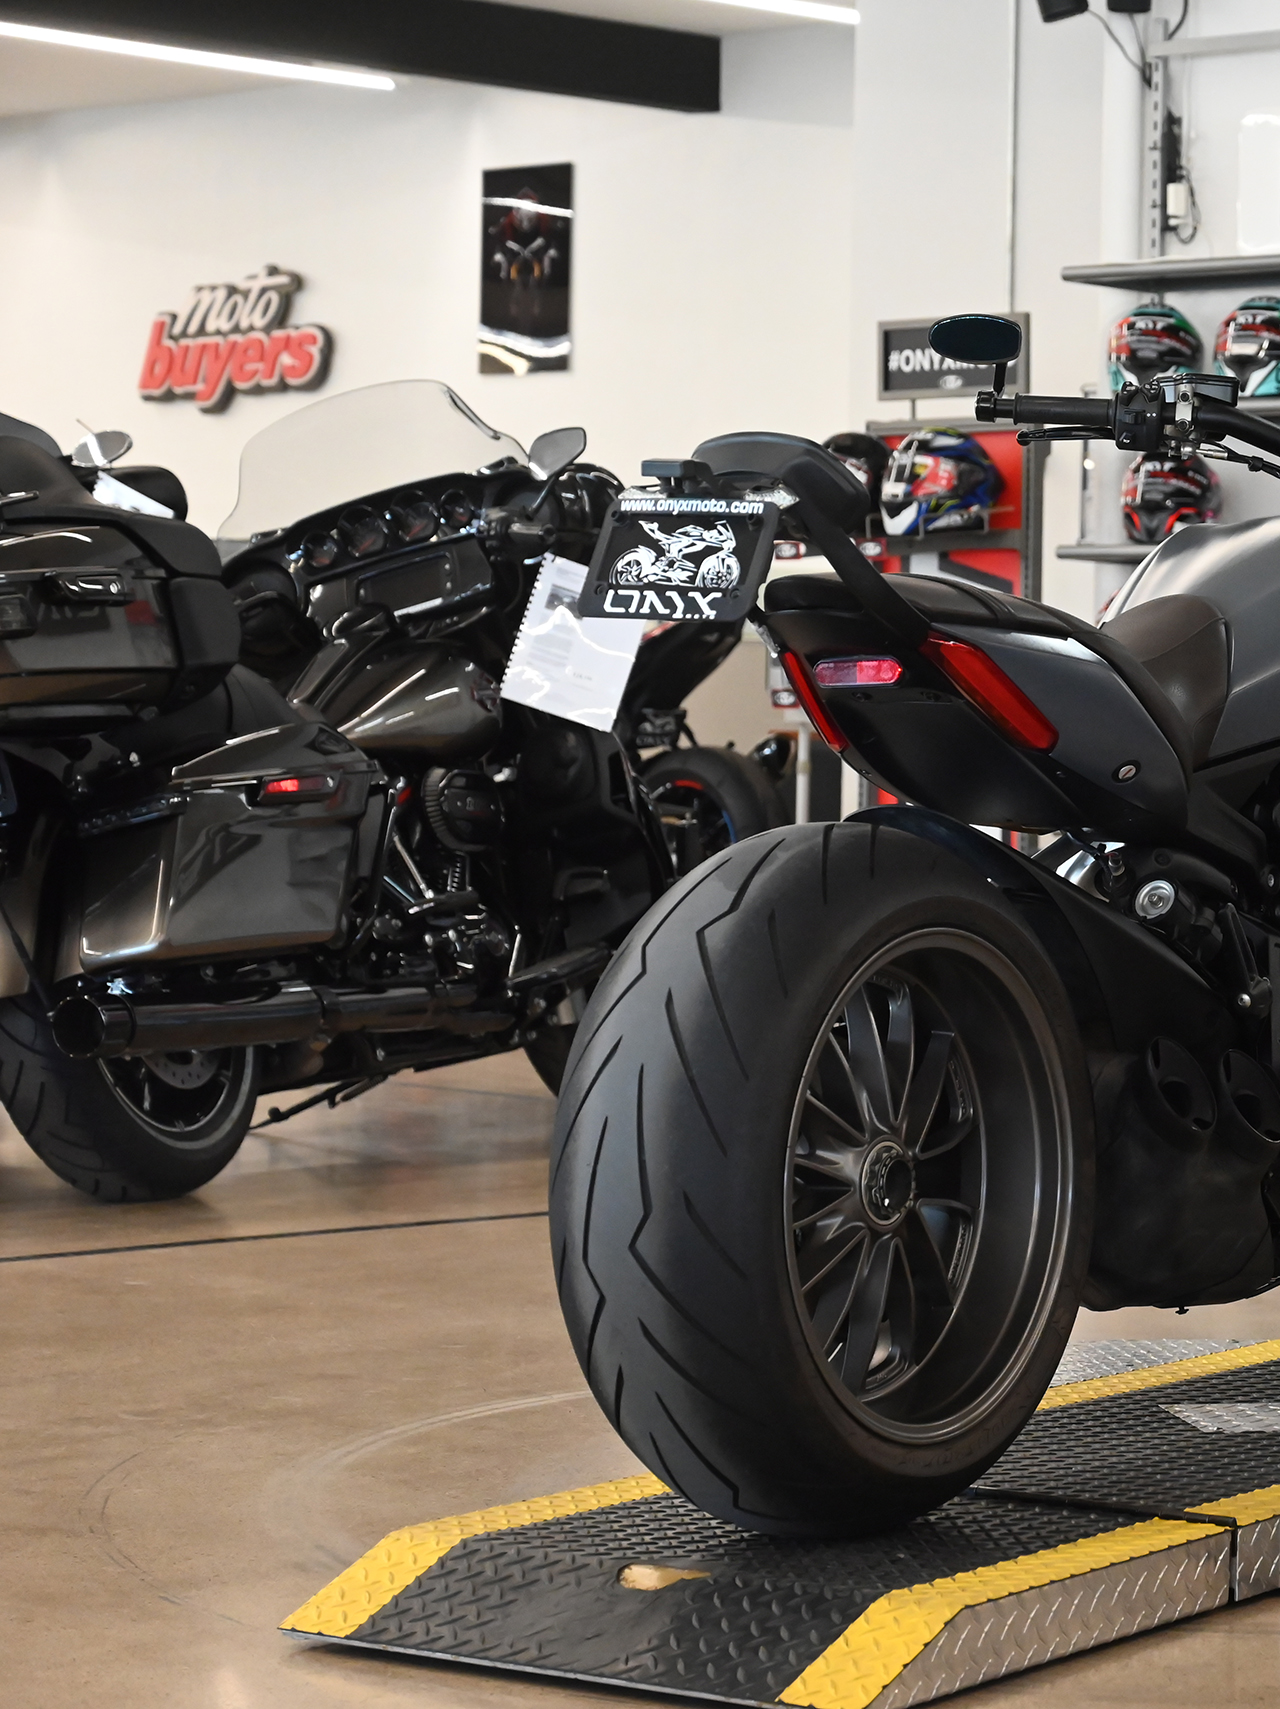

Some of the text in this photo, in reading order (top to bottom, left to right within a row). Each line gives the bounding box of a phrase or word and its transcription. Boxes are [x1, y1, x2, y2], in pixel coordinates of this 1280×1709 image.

[139, 317, 319, 405] buyers
[620, 498, 765, 515] www.onyxmoto.com
[603, 588, 723, 619] ONYX
